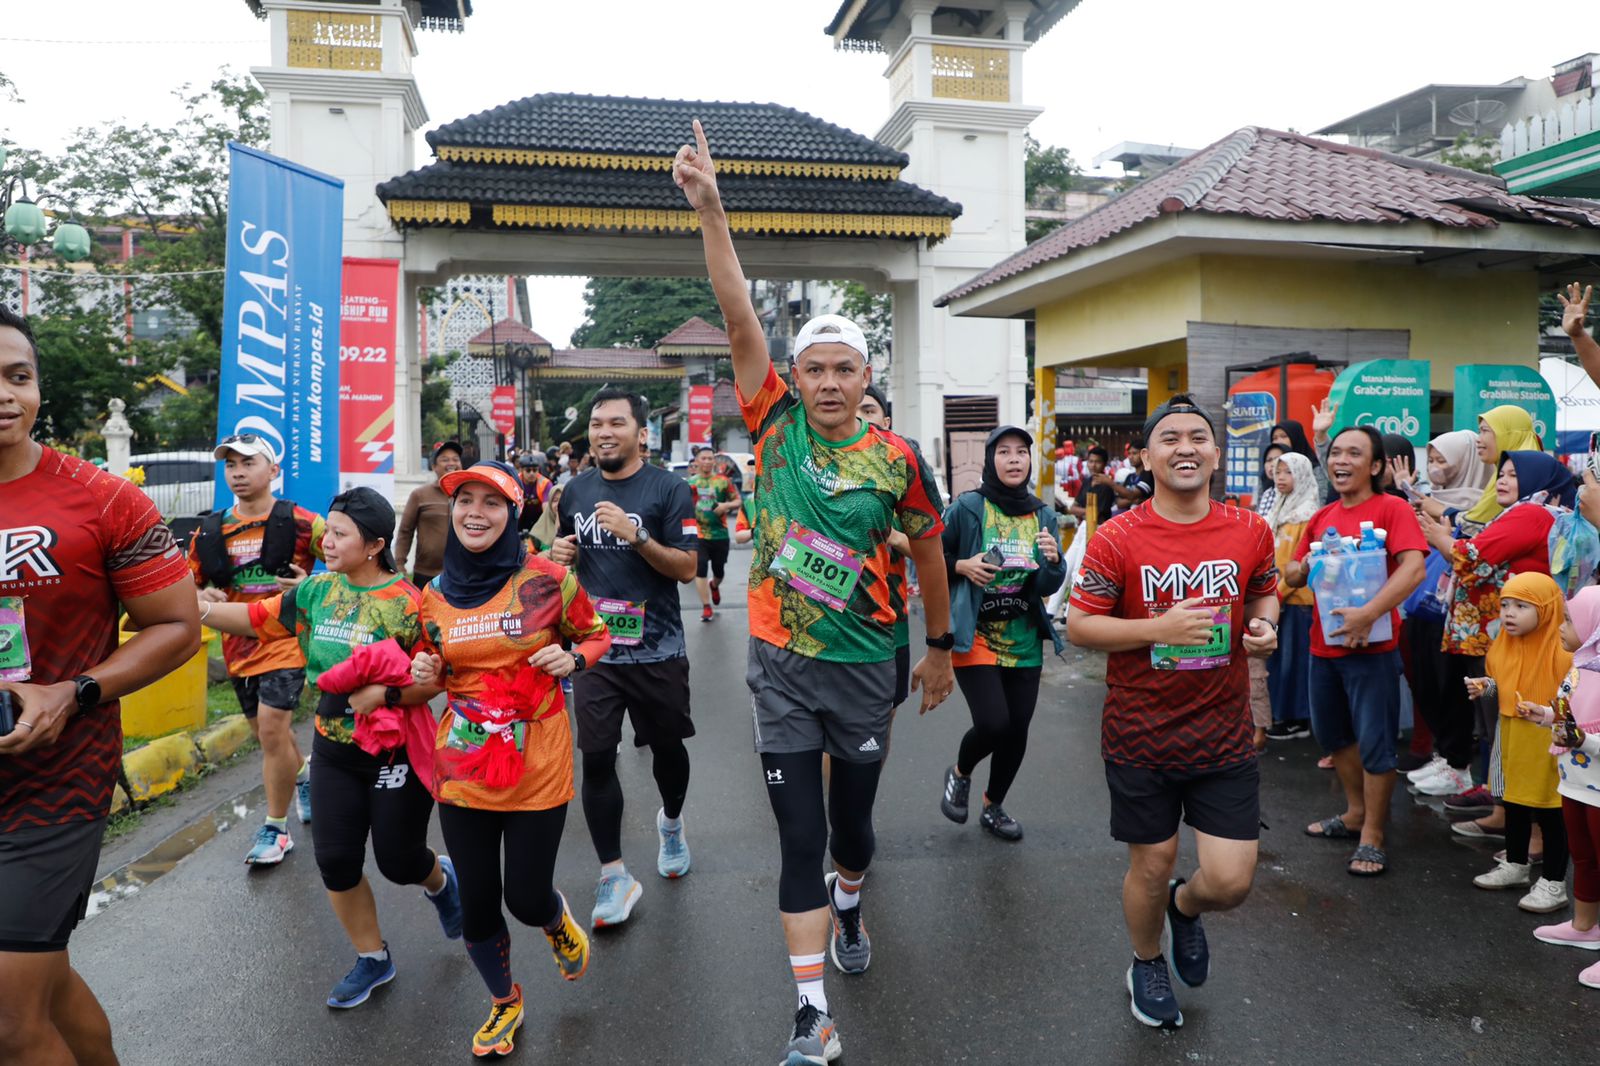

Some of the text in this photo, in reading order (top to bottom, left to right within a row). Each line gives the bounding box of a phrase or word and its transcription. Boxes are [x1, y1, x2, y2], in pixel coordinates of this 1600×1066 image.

[344, 295, 379, 305] JATENG
[368, 305, 389, 318] RUN
[291, 284, 303, 479] AMANAT HATI NURANI RAKYAT
[307, 301, 325, 463] www.kompas.id
[1361, 375, 1417, 384] Istana Maimoon
[1488, 380, 1542, 389] Istana Maimoon
[1353, 385, 1424, 396] GrabCar Station
[1479, 389, 1550, 401] GrabBike Station
[1354, 408, 1420, 436] Grab
[802, 551, 850, 588] 1801
[1, 577, 62, 590] RUNNERS
[1141, 559, 1240, 602] MMR
[456, 611, 512, 625] BANK JATENG
[314, 624, 356, 641] FRIENDSHIP
[356, 632, 374, 644] RUN
[448, 618, 522, 638] FRIENDSHIP RUN
